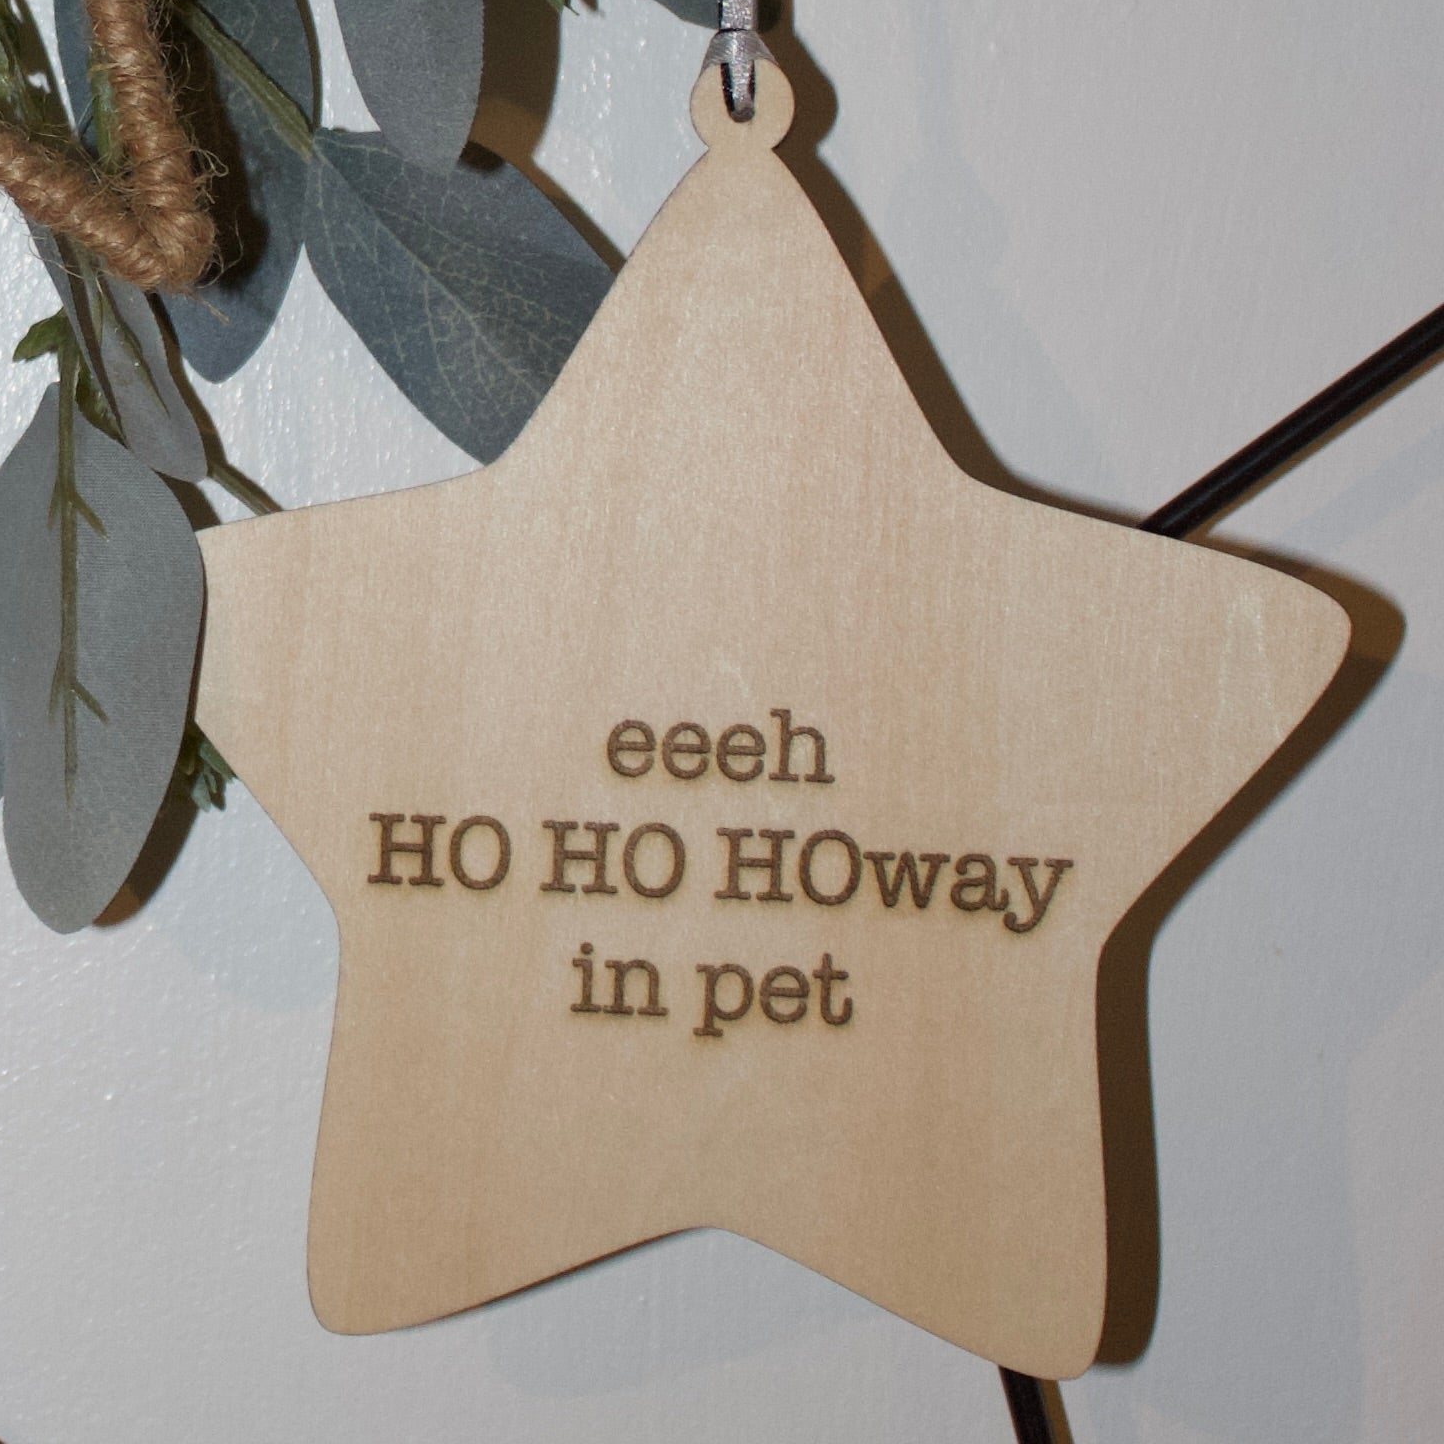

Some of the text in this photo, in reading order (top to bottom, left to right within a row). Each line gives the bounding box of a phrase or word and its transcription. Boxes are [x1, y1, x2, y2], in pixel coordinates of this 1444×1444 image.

[606, 708, 836, 786] eeeh
[367, 812, 1075, 935] HO HO HOway
[570, 942, 855, 1039] in pet
